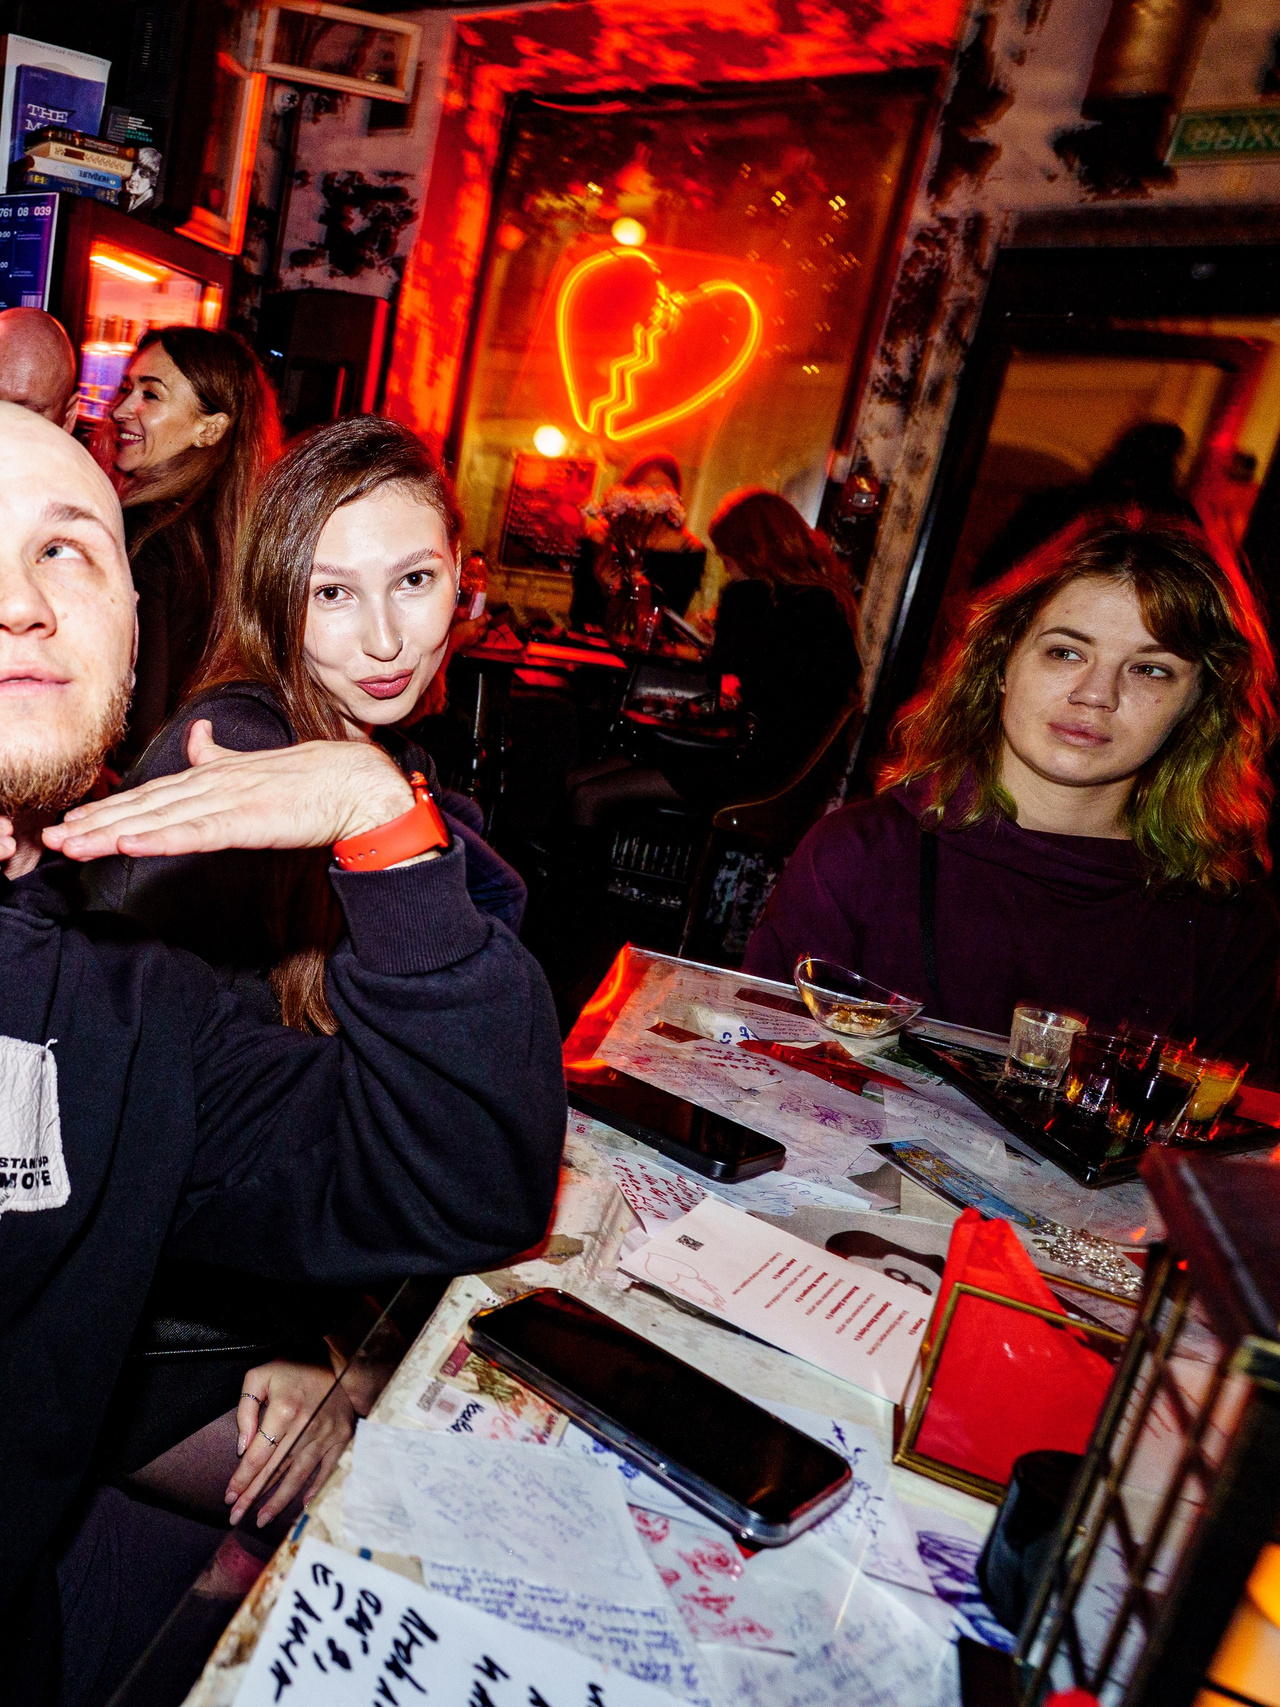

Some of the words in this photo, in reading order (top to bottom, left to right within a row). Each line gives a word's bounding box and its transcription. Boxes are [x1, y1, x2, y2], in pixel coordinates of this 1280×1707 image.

[26, 103, 69, 123] THE
[17, 207, 29, 217] 08
[34, 206, 52, 216] 039
